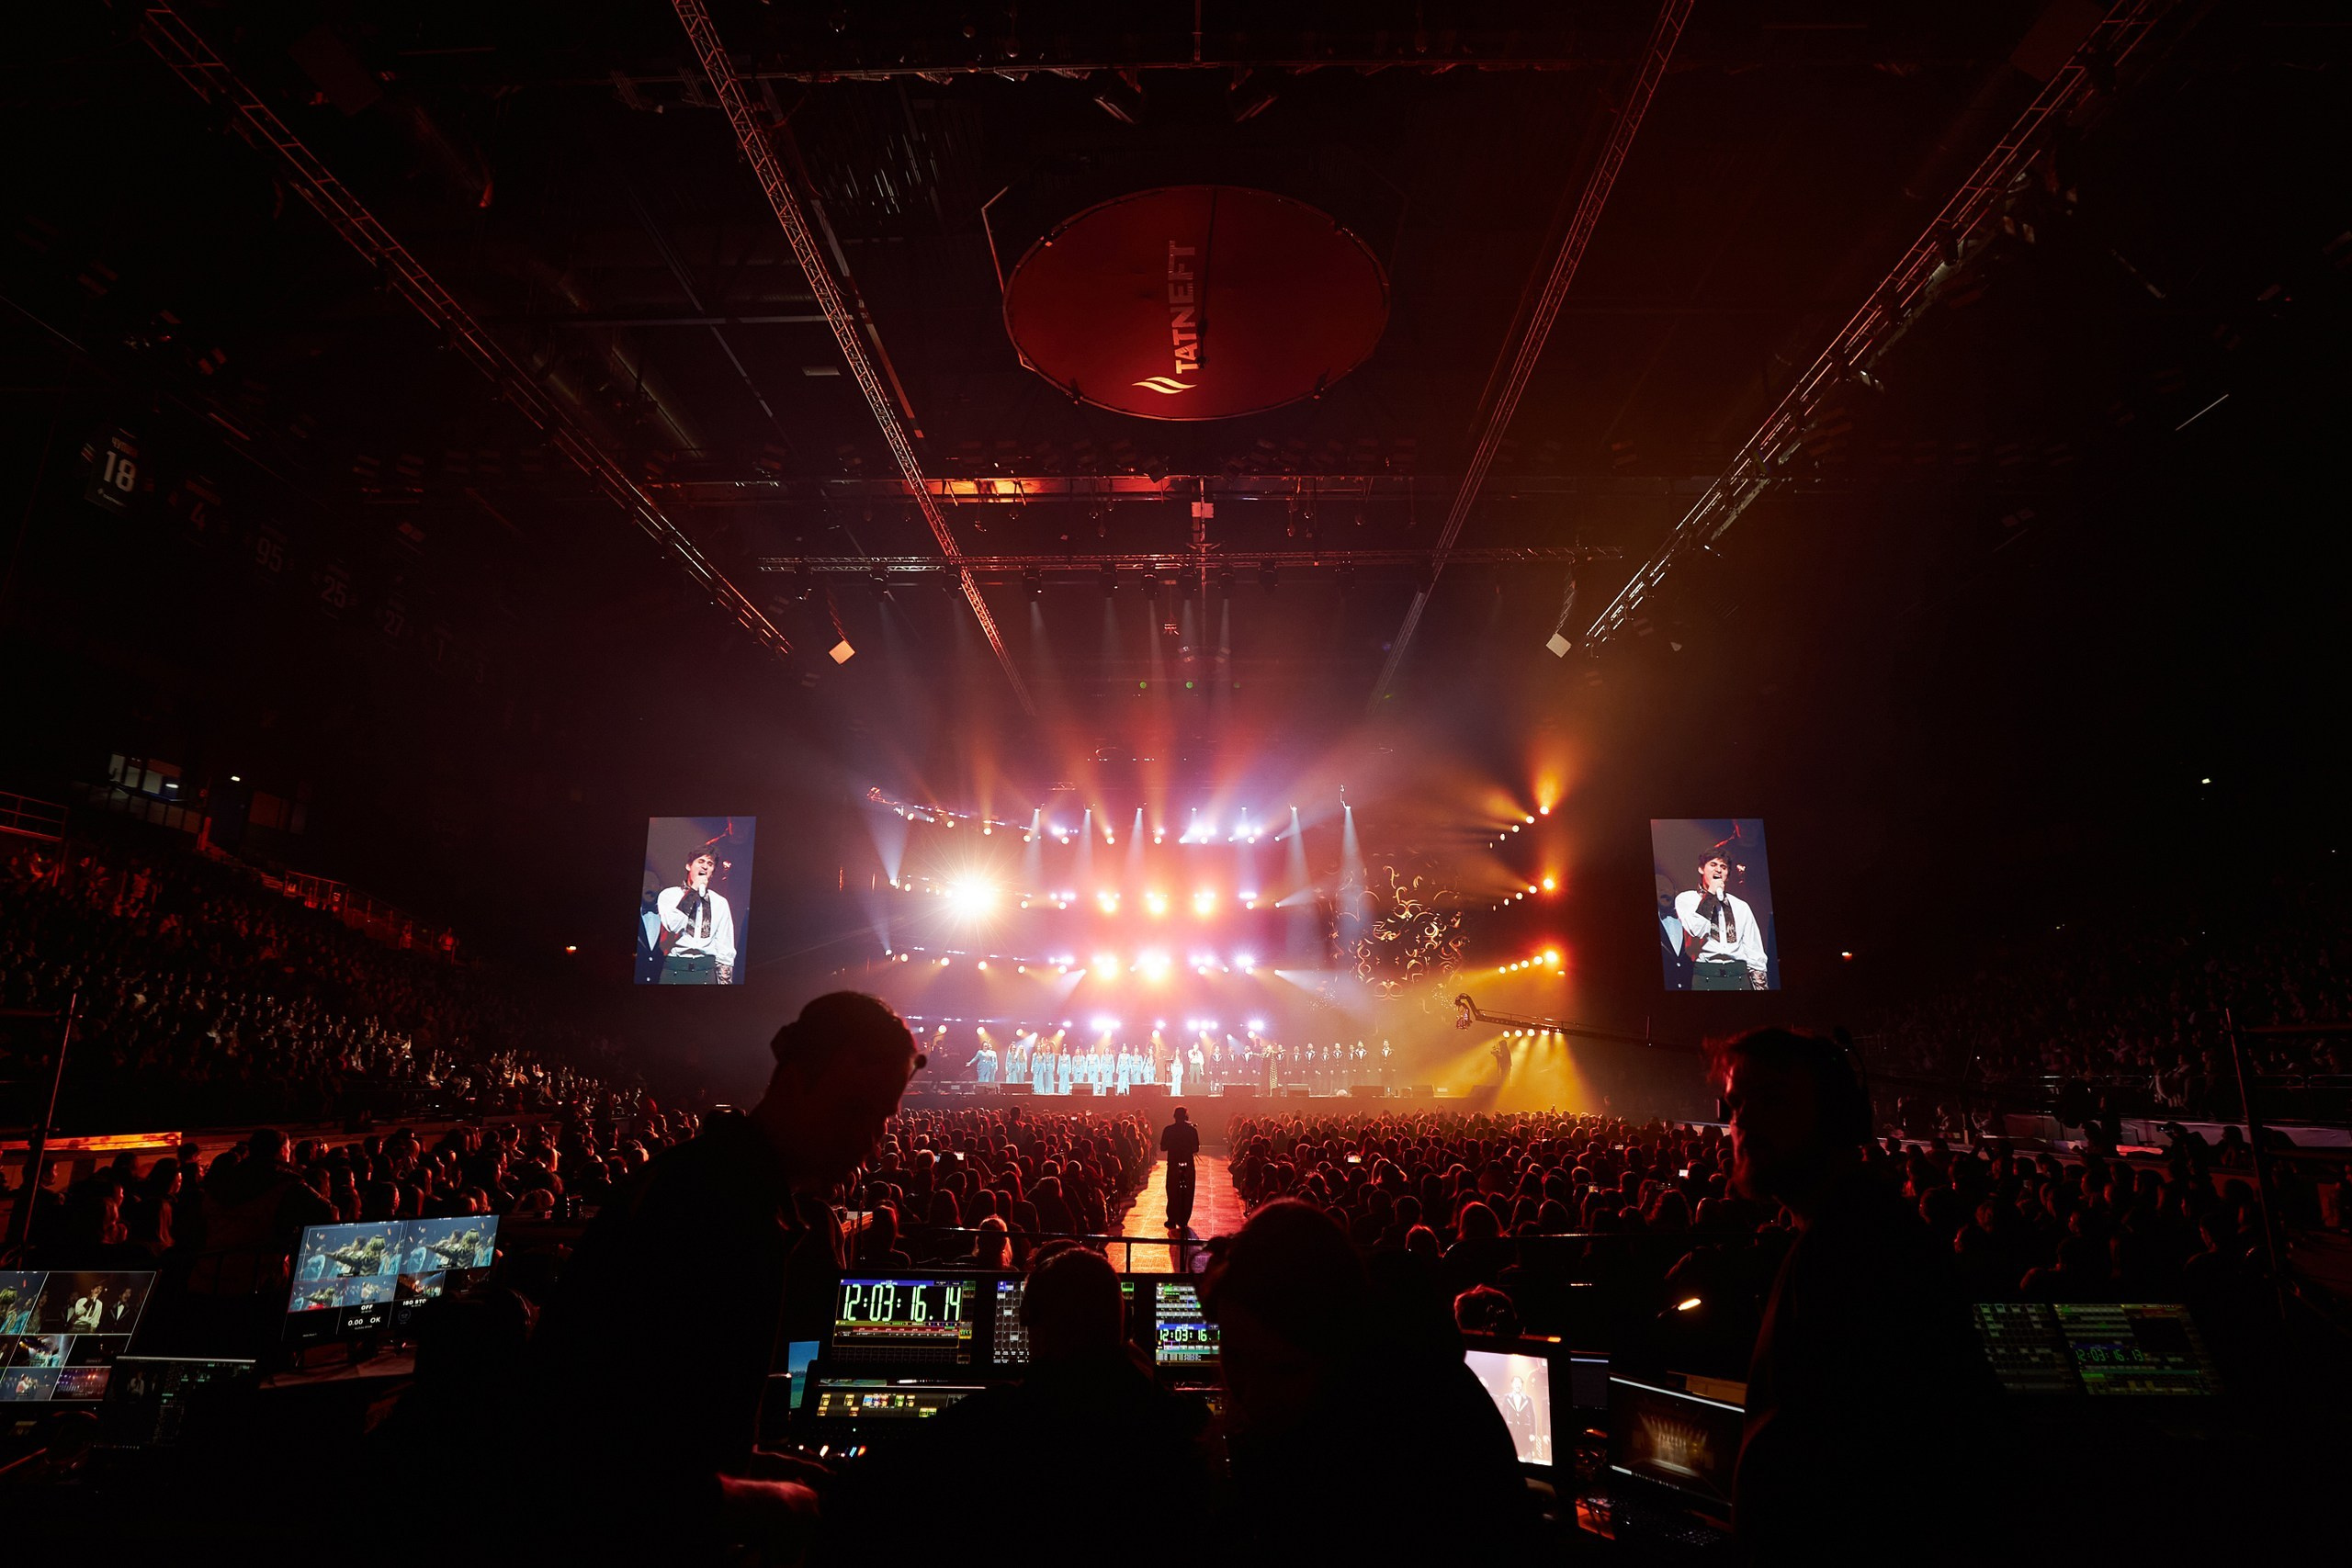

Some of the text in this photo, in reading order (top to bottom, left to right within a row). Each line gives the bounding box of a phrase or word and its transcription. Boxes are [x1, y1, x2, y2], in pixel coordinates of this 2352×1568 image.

[1167, 240, 1201, 375] TATNEFT
[103, 449, 137, 493] 18
[190, 501, 207, 532] 4
[255, 536, 285, 573] 95
[320, 574, 348, 610] 25
[1159, 1328, 1221, 1342] 12:03:16.1
